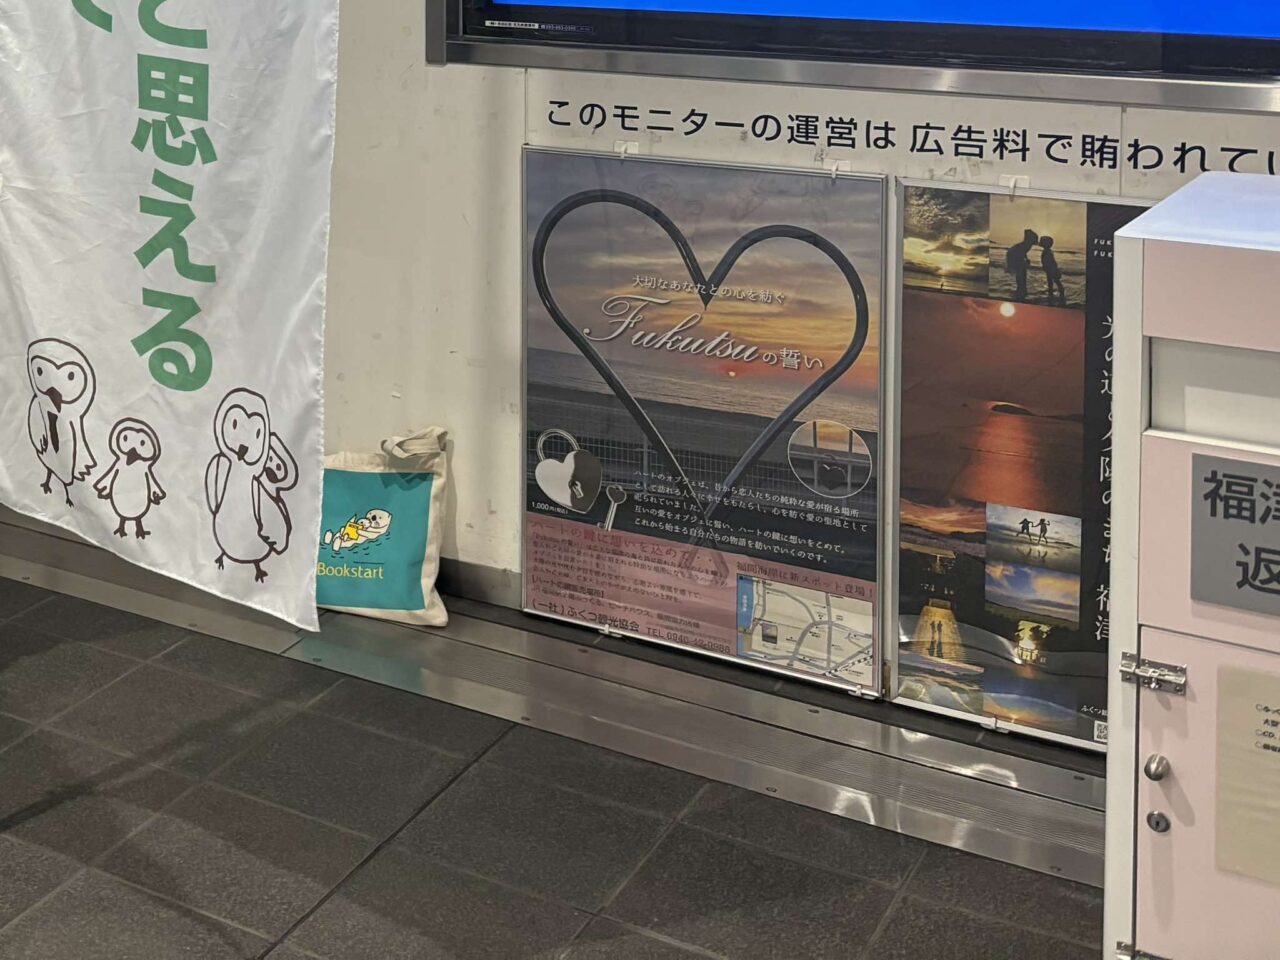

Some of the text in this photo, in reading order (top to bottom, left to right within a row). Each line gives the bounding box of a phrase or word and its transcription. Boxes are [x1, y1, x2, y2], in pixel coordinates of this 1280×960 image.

[632, 275, 785, 304] 大切なあなたとの心を紡ぐ
[317, 562, 384, 580] Bookstart
